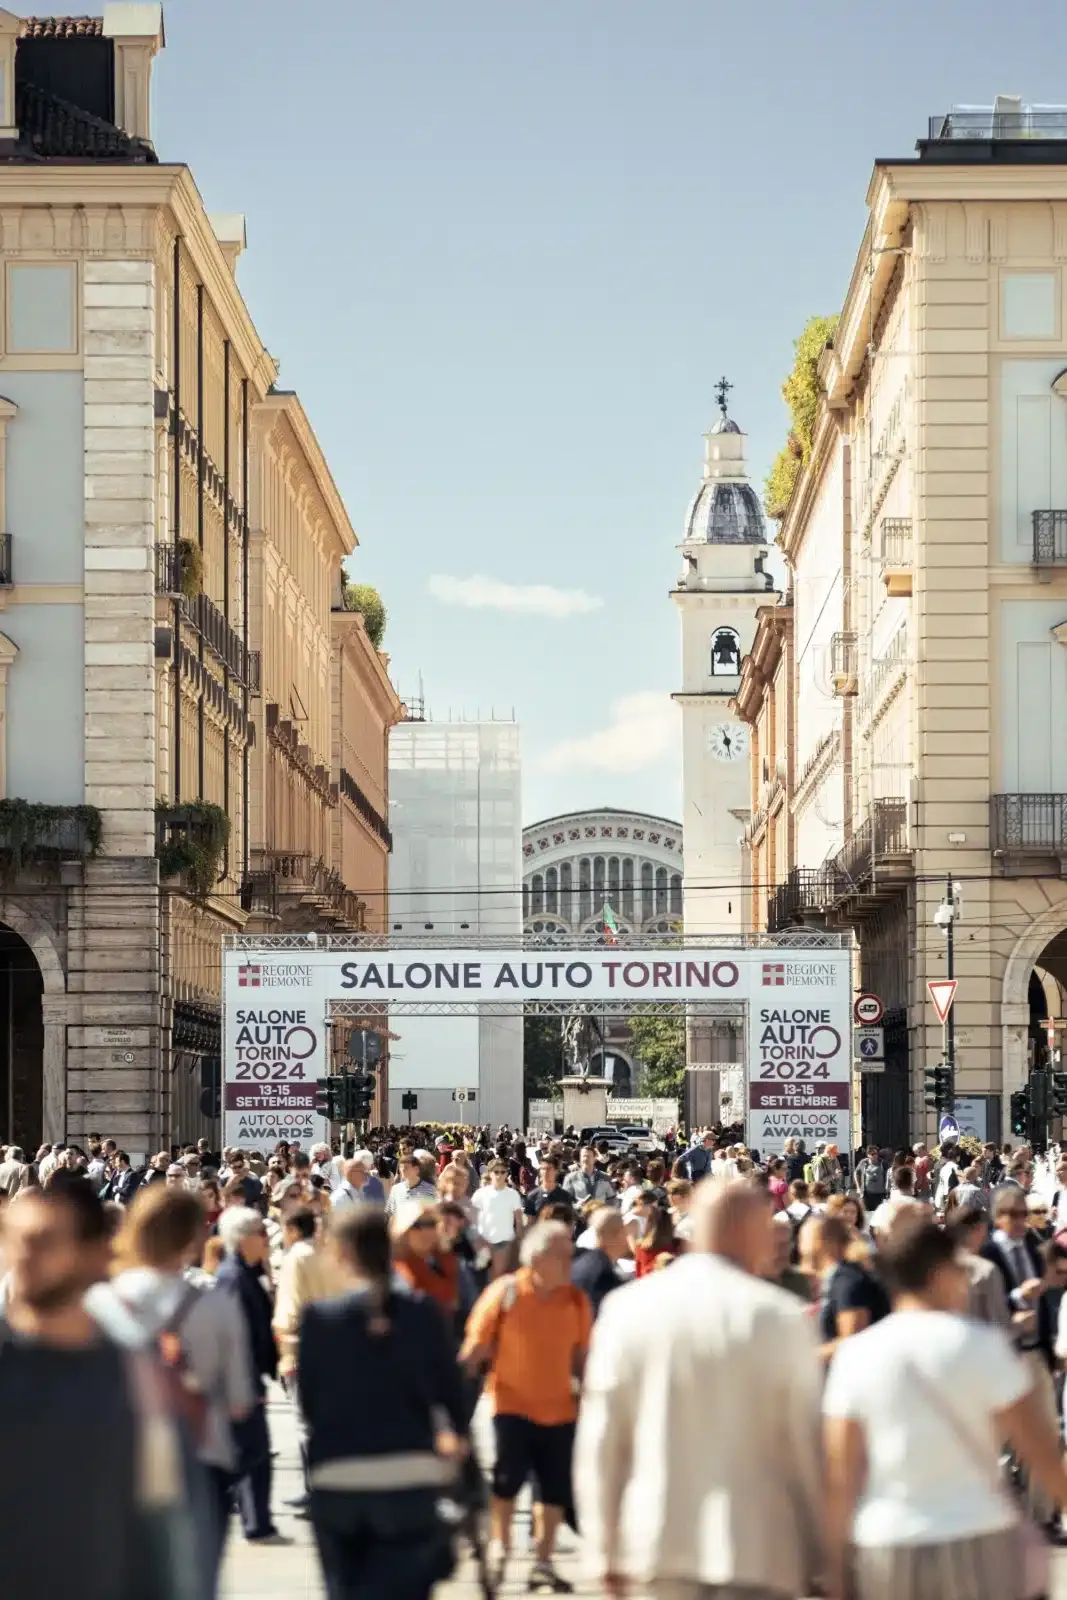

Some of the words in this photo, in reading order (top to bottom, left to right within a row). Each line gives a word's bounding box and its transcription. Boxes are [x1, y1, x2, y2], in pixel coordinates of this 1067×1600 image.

[261, 965, 313, 976] REGIONE
[340, 962, 482, 989] SALONE
[493, 961, 593, 989] AUTO
[602, 961, 740, 988] TORINO
[786, 964, 837, 975] REGIONE
[261, 977, 313, 987] PIEMONTE
[786, 976, 837, 986] PIEMONTE
[236, 1010, 306, 1024] SALONE
[760, 1009, 831, 1023] SALONE
[235, 1062, 306, 1080] 2024
[760, 1061, 831, 1079] 2024
[259, 1084, 290, 1096] 13-15
[783, 1083, 815, 1095] 13-15
[236, 1096, 313, 1107] SETTEMBRE
[760, 1095, 838, 1107] SETTEMBRE
[239, 1114, 314, 1126] AUTOLOOK
[763, 1113, 838, 1125] AUTOLOOK
[238, 1127, 314, 1138] AWARDS
[762, 1127, 838, 1138] AWARDS
